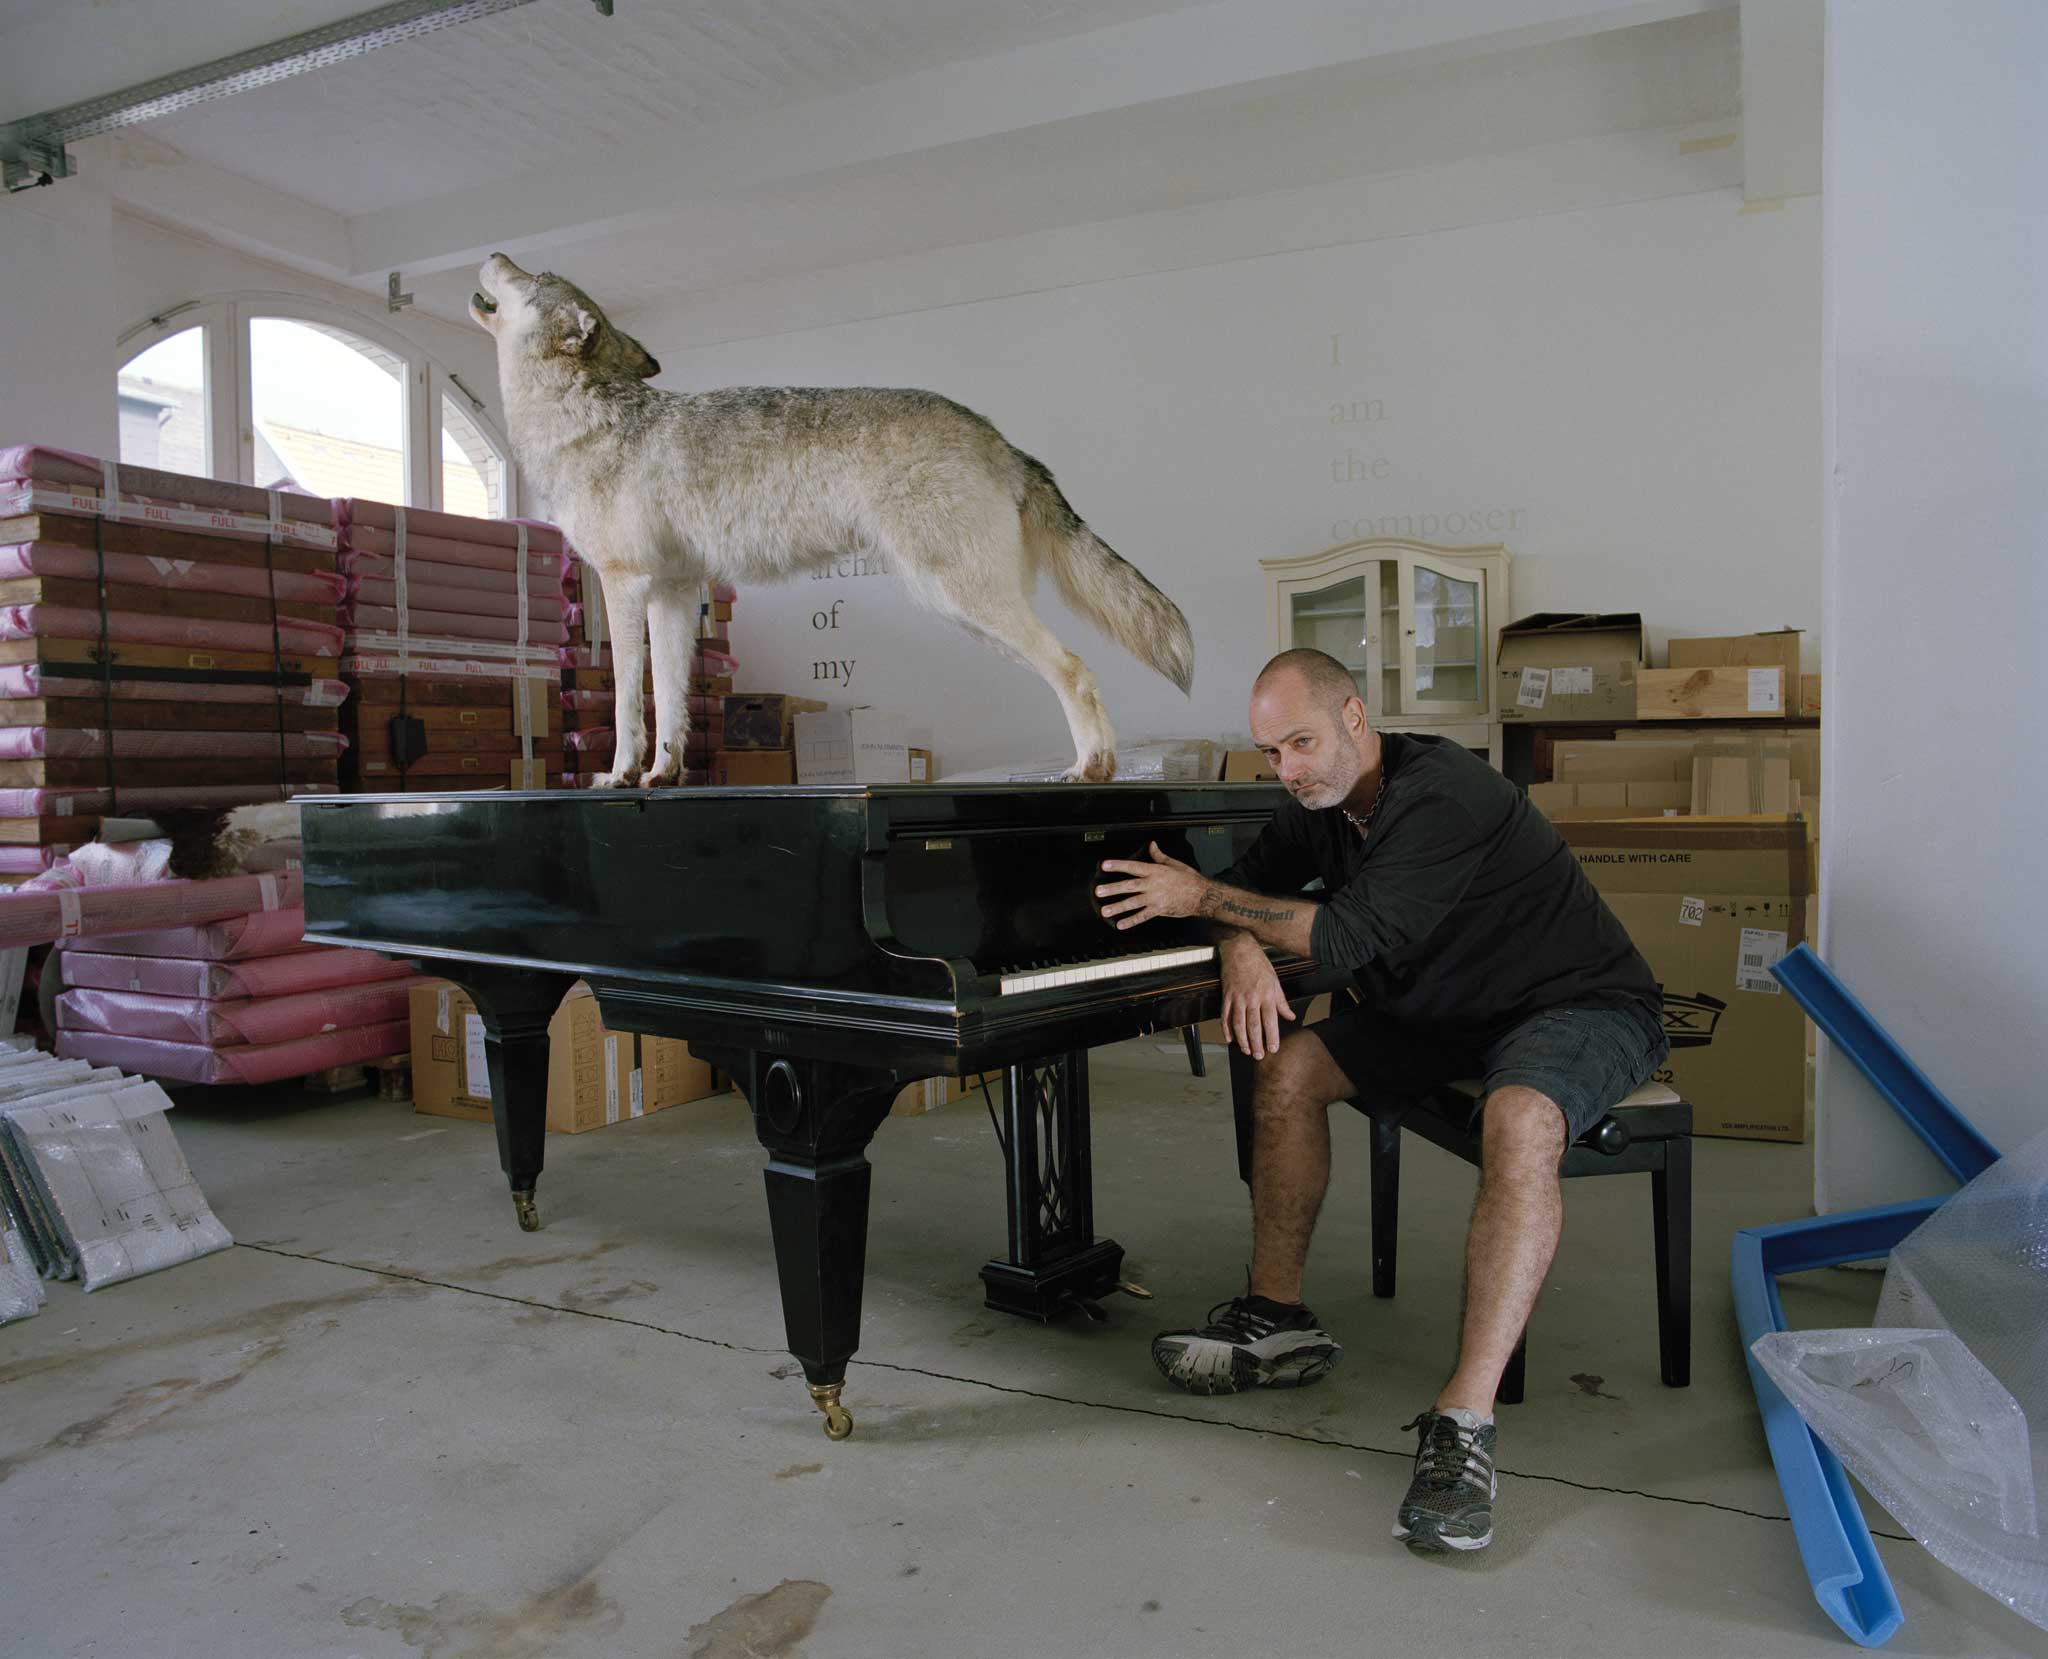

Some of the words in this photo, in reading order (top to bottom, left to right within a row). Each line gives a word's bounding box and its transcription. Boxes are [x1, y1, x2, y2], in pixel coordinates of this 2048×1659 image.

[1330, 333, 1342, 368] I
[1329, 399, 1391, 425] am
[1330, 447, 1391, 482] the
[72, 497, 103, 512] FULL
[144, 507, 172, 521] FULL
[211, 515, 238, 529] FULL
[274, 523, 298, 537] FULL
[1331, 507, 1527, 543] composer
[812, 599, 844, 630] of
[419, 662, 438, 672] FULL
[812, 659, 857, 688] my
[1579, 854, 1625, 864] HANDLE
[1628, 854, 1657, 863] WITH
[1660, 853, 1692, 863] CARE
[1682, 904, 1703, 920] 702
